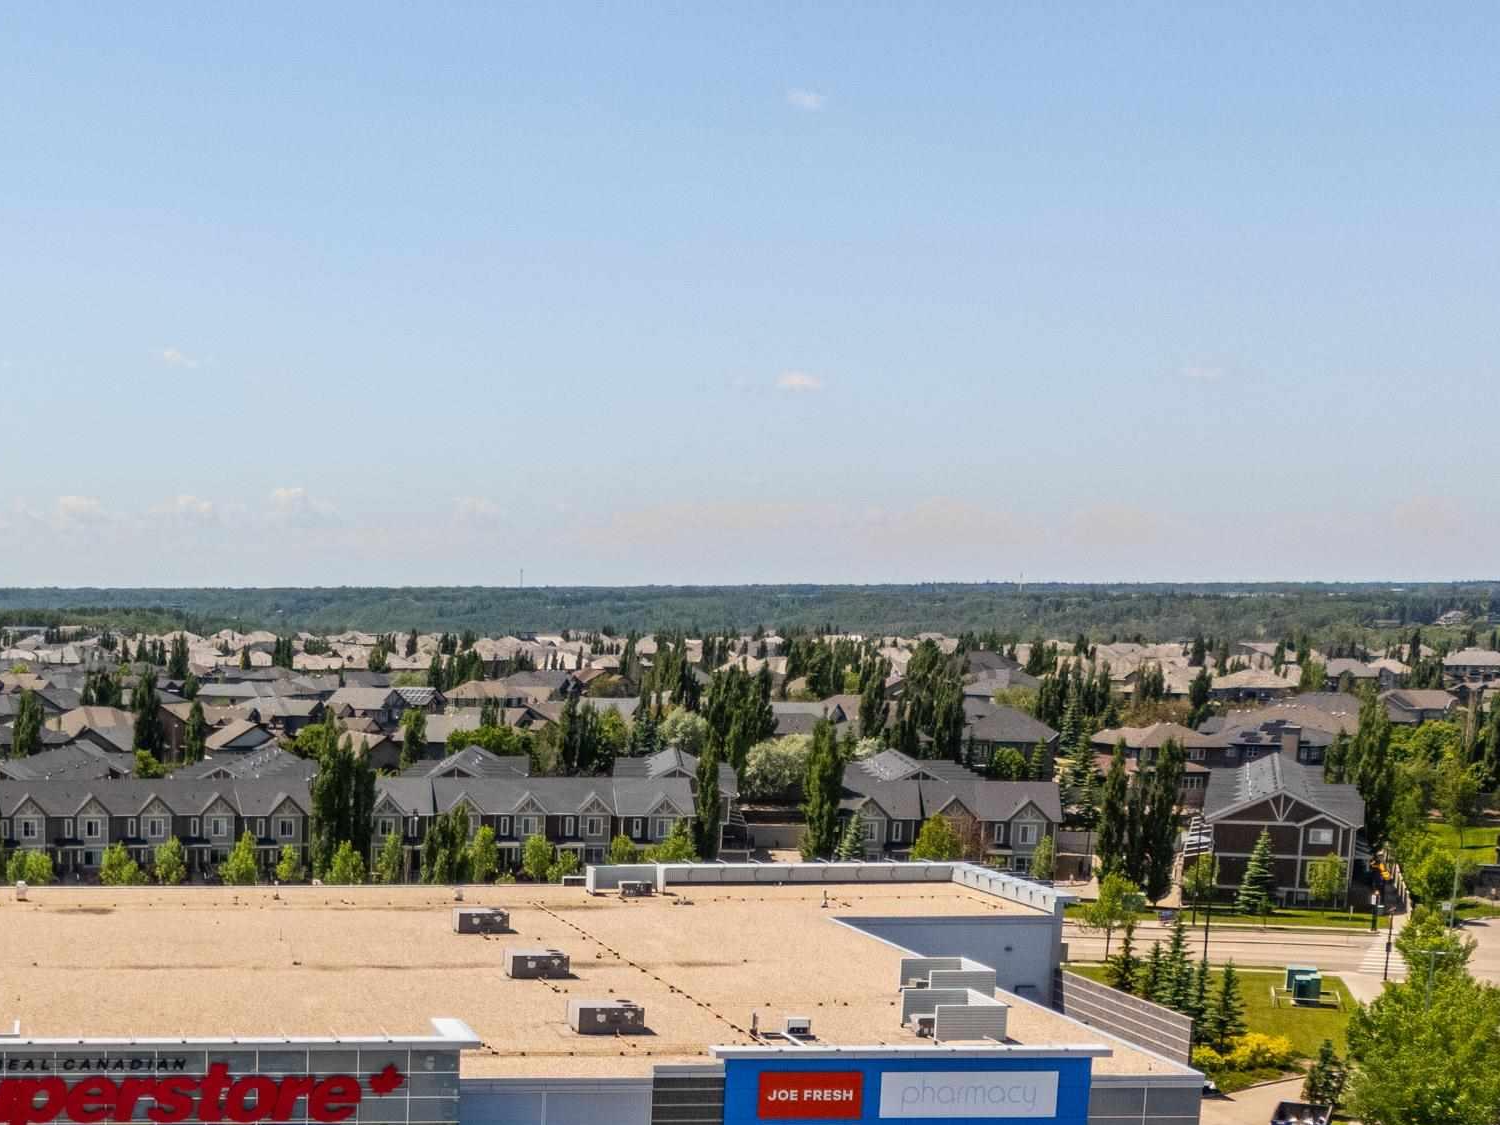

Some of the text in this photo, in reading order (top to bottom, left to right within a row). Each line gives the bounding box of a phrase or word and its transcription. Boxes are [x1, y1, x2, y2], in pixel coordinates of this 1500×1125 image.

[63, 1057, 187, 1070] CANADIAN
[767, 1089, 854, 1101] JOE FRESH
[901, 1080, 1037, 1113] pharmacy
